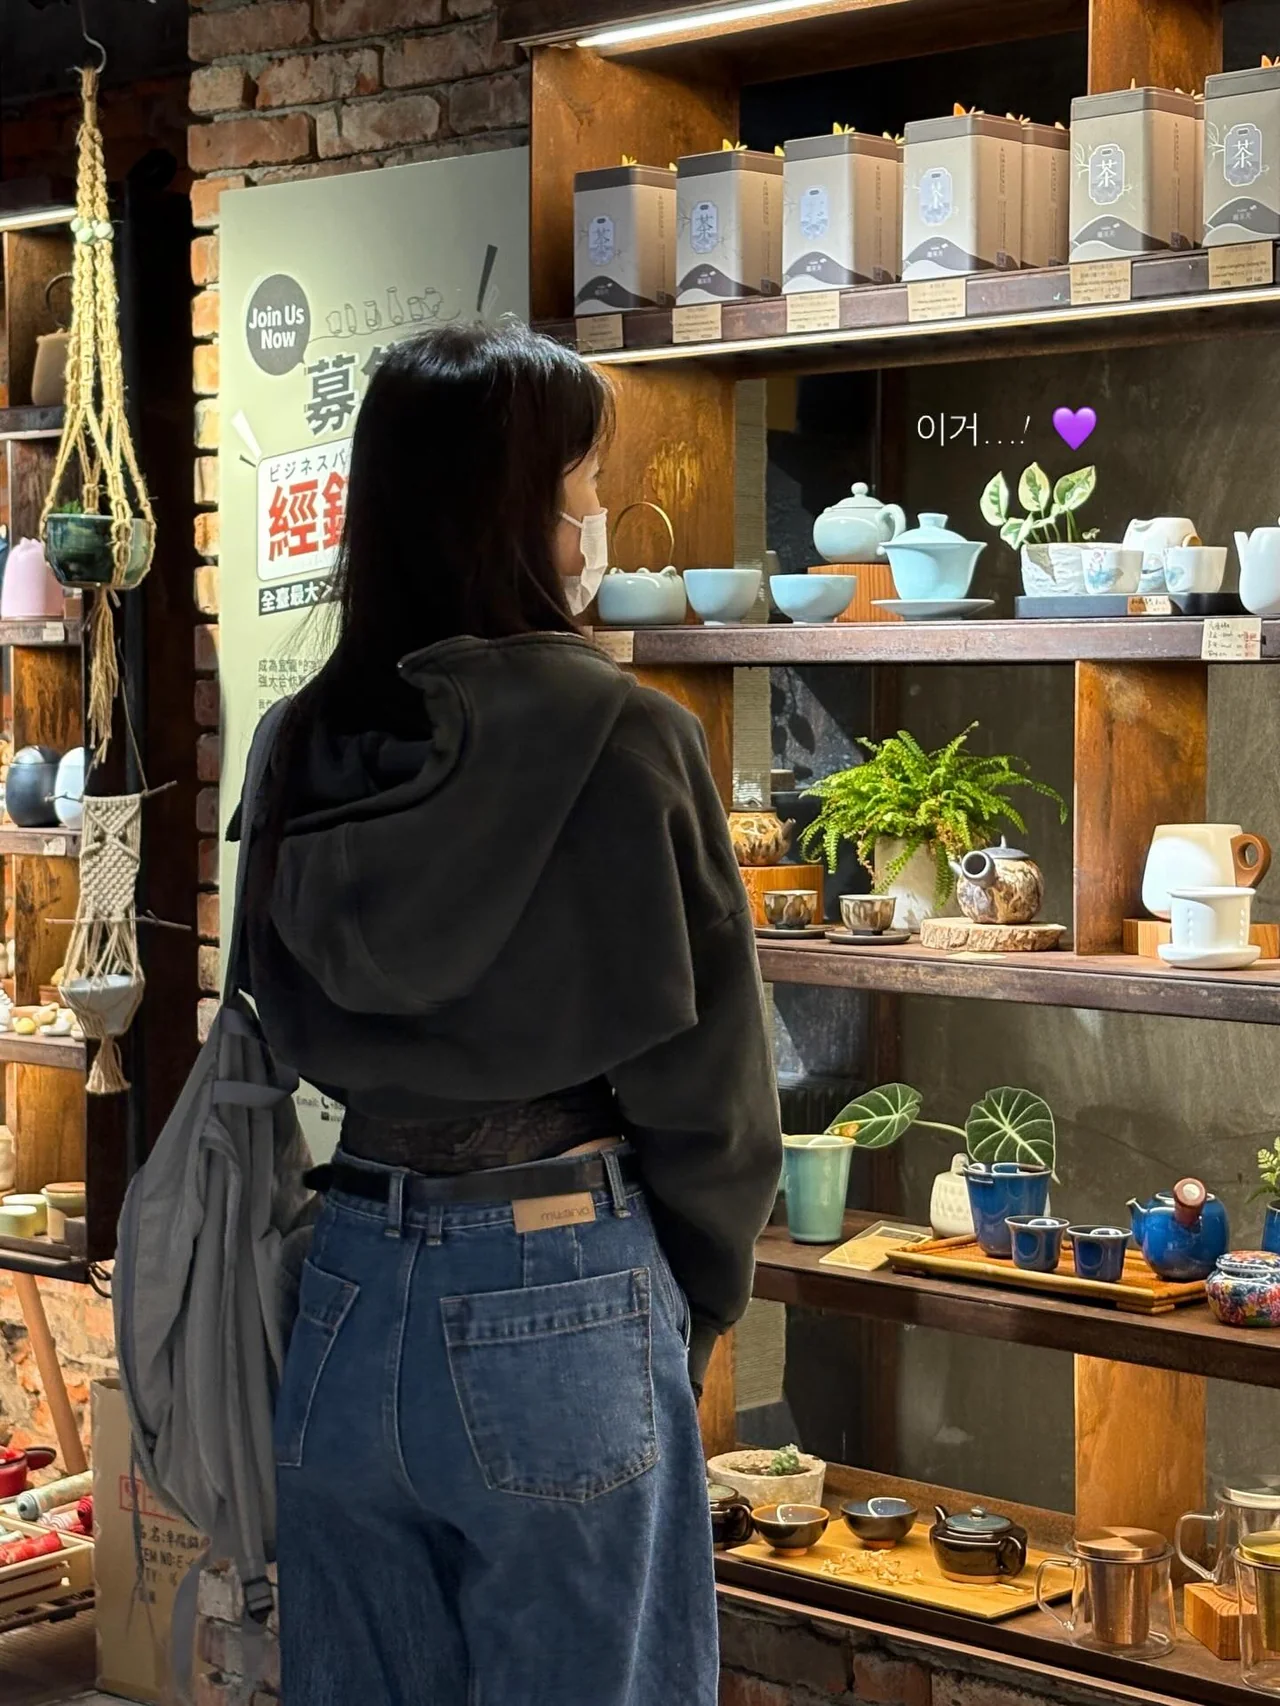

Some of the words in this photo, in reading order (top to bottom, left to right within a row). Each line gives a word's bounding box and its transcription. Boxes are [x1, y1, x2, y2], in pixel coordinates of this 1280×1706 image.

[1232, 139, 1255, 169] 茶
[1096, 159, 1117, 188] 茶
[249, 305, 282, 329] Join
[284, 304, 305, 326] Us
[260, 329, 297, 350] Now
